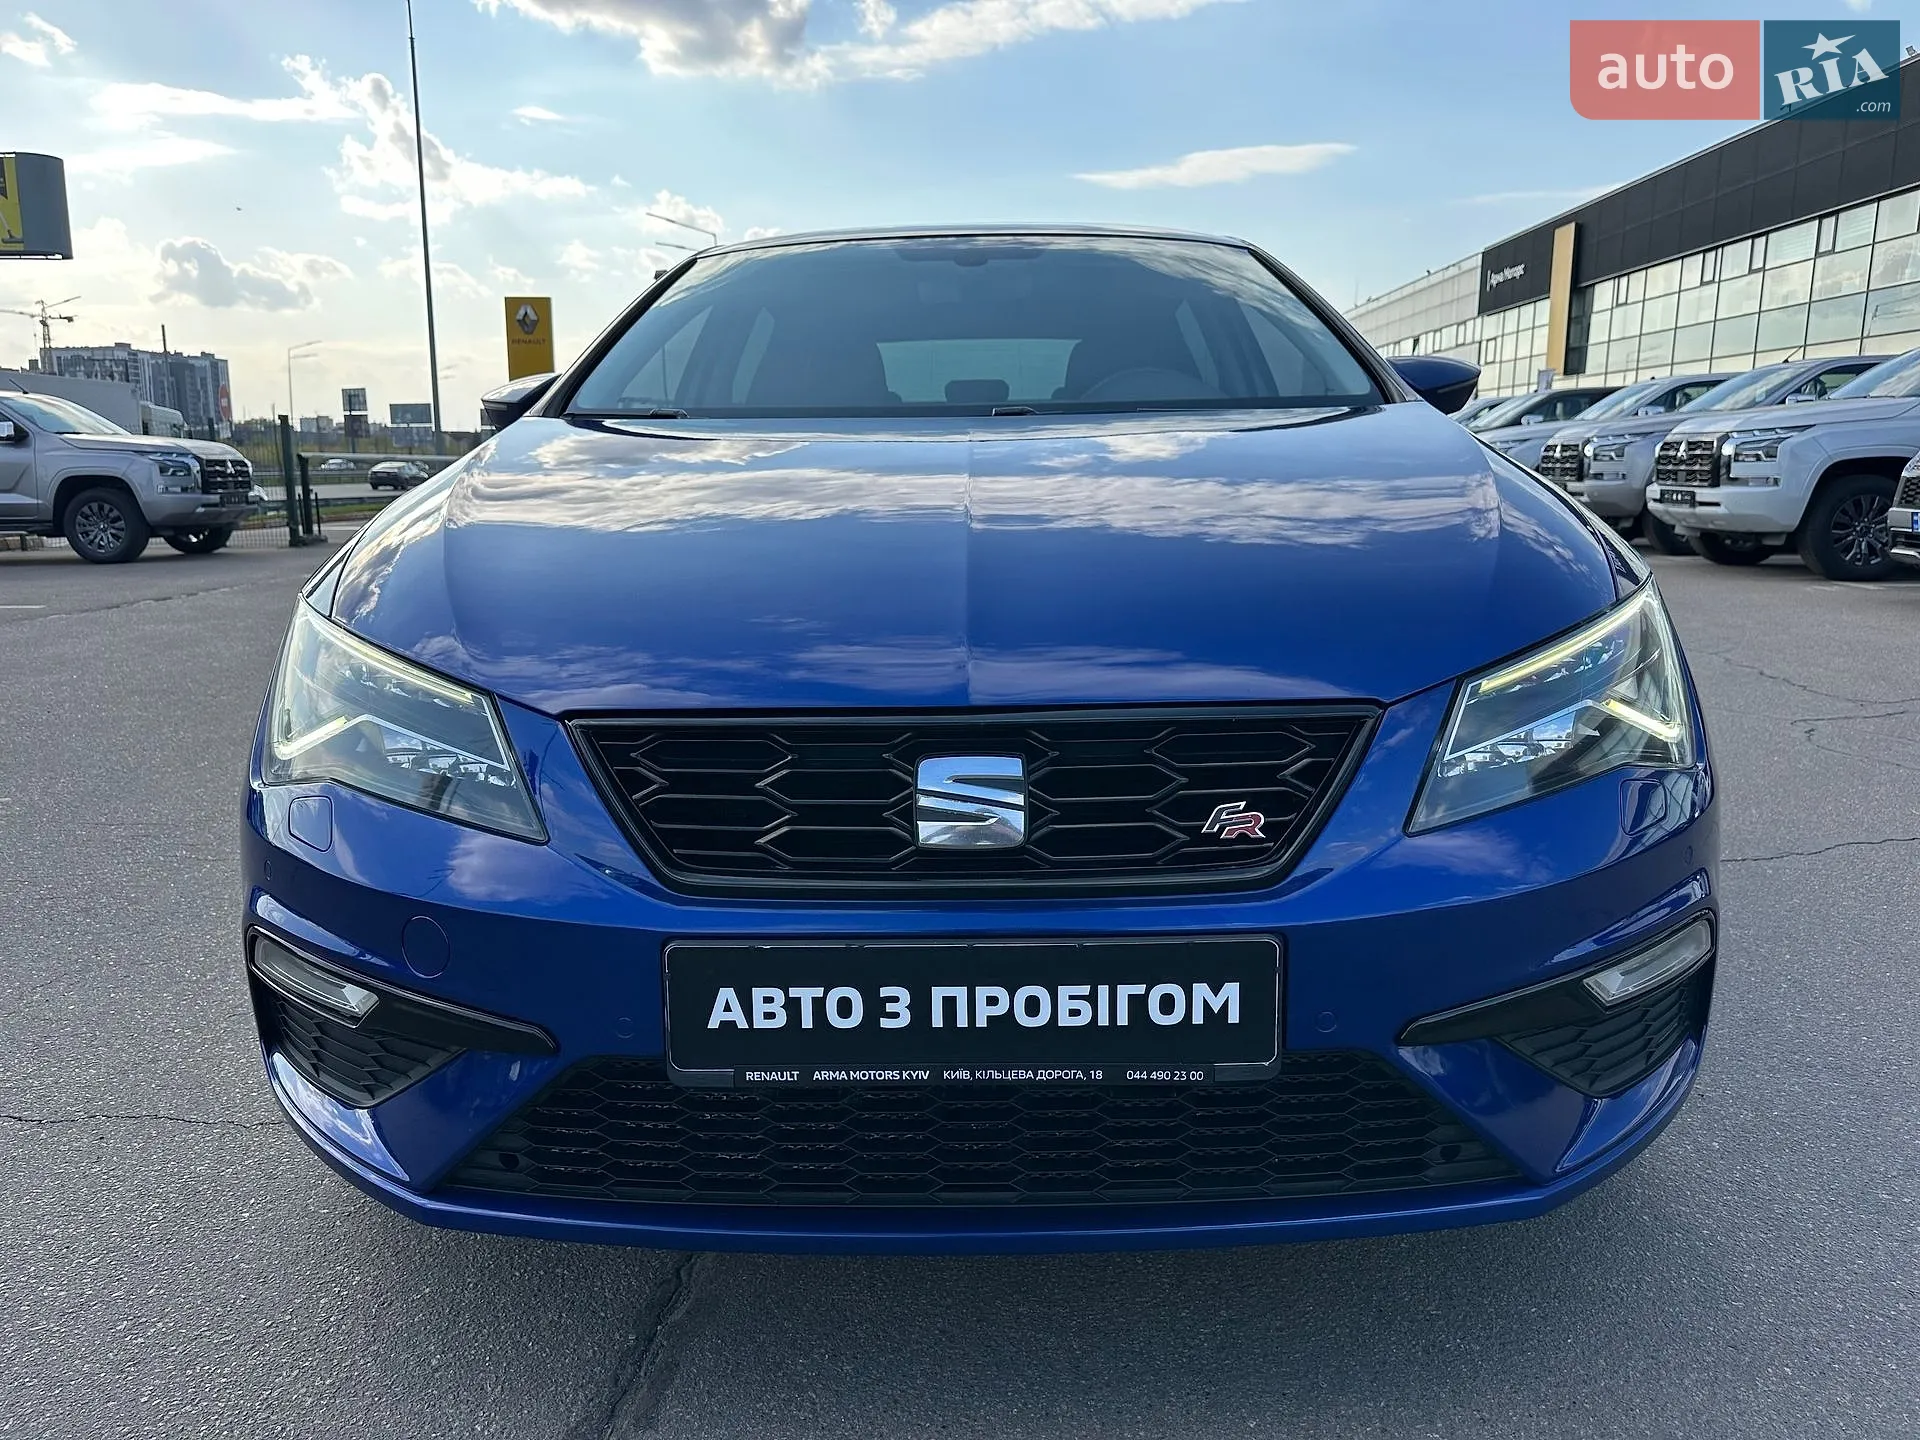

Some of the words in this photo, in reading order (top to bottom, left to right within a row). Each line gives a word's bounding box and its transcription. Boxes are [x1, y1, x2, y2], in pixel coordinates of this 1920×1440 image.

[1201, 801, 1266, 839] FR
[707, 986, 864, 1029] АВТО
[931, 981, 1241, 1029] ПРОБІГОМ
[745, 1071, 800, 1081] RENAULT
[812, 1071, 848, 1081] ARMA
[849, 1071, 900, 1081] MOTORS
[902, 1070, 930, 1081] KYIV
[943, 1068, 973, 1082] КИЇВ,
[975, 1070, 1034, 1082] КІЛЬЦЕВА
[1035, 1070, 1087, 1082] ДОРОГА,
[1089, 1070, 1103, 1080] 18
[1126, 1070, 1148, 1081] 044
[1149, 1070, 1172, 1081] 490
[1173, 1070, 1187, 1081] 23
[1189, 1070, 1204, 1081] 00
